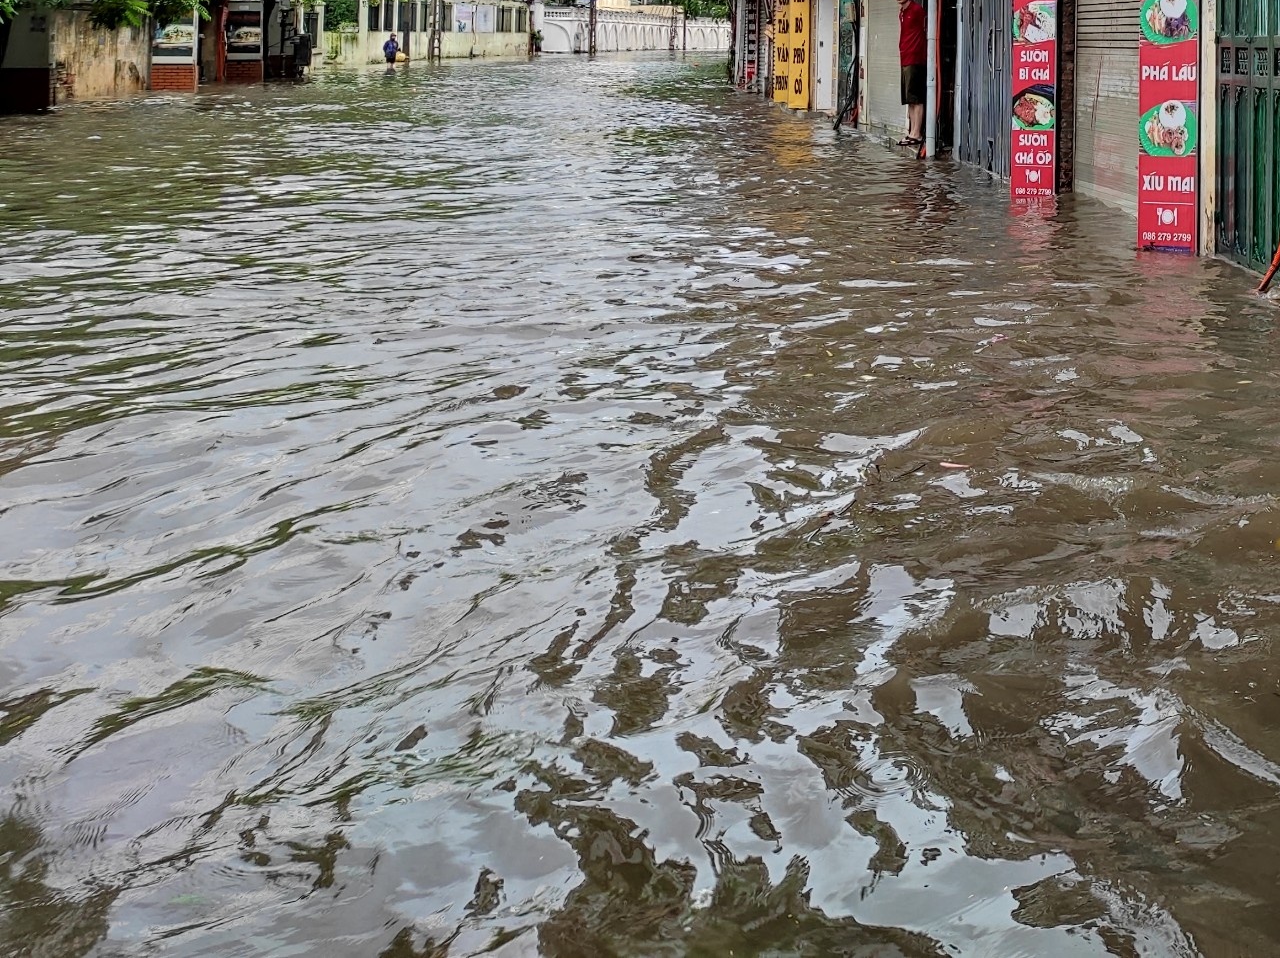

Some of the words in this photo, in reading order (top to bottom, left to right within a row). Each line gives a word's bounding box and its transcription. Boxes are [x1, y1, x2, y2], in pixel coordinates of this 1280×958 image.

[1142, 61, 1168, 81] PHÁ
[775, 71, 788, 90] PHÒN
[1015, 148, 1034, 164] CHẢ
[1142, 172, 1164, 192] XÍU
[1026, 187, 1037, 195] 279
[1142, 231, 1156, 241] 086
[1157, 232, 1171, 241] 279
[1173, 232, 1192, 242] 2799
